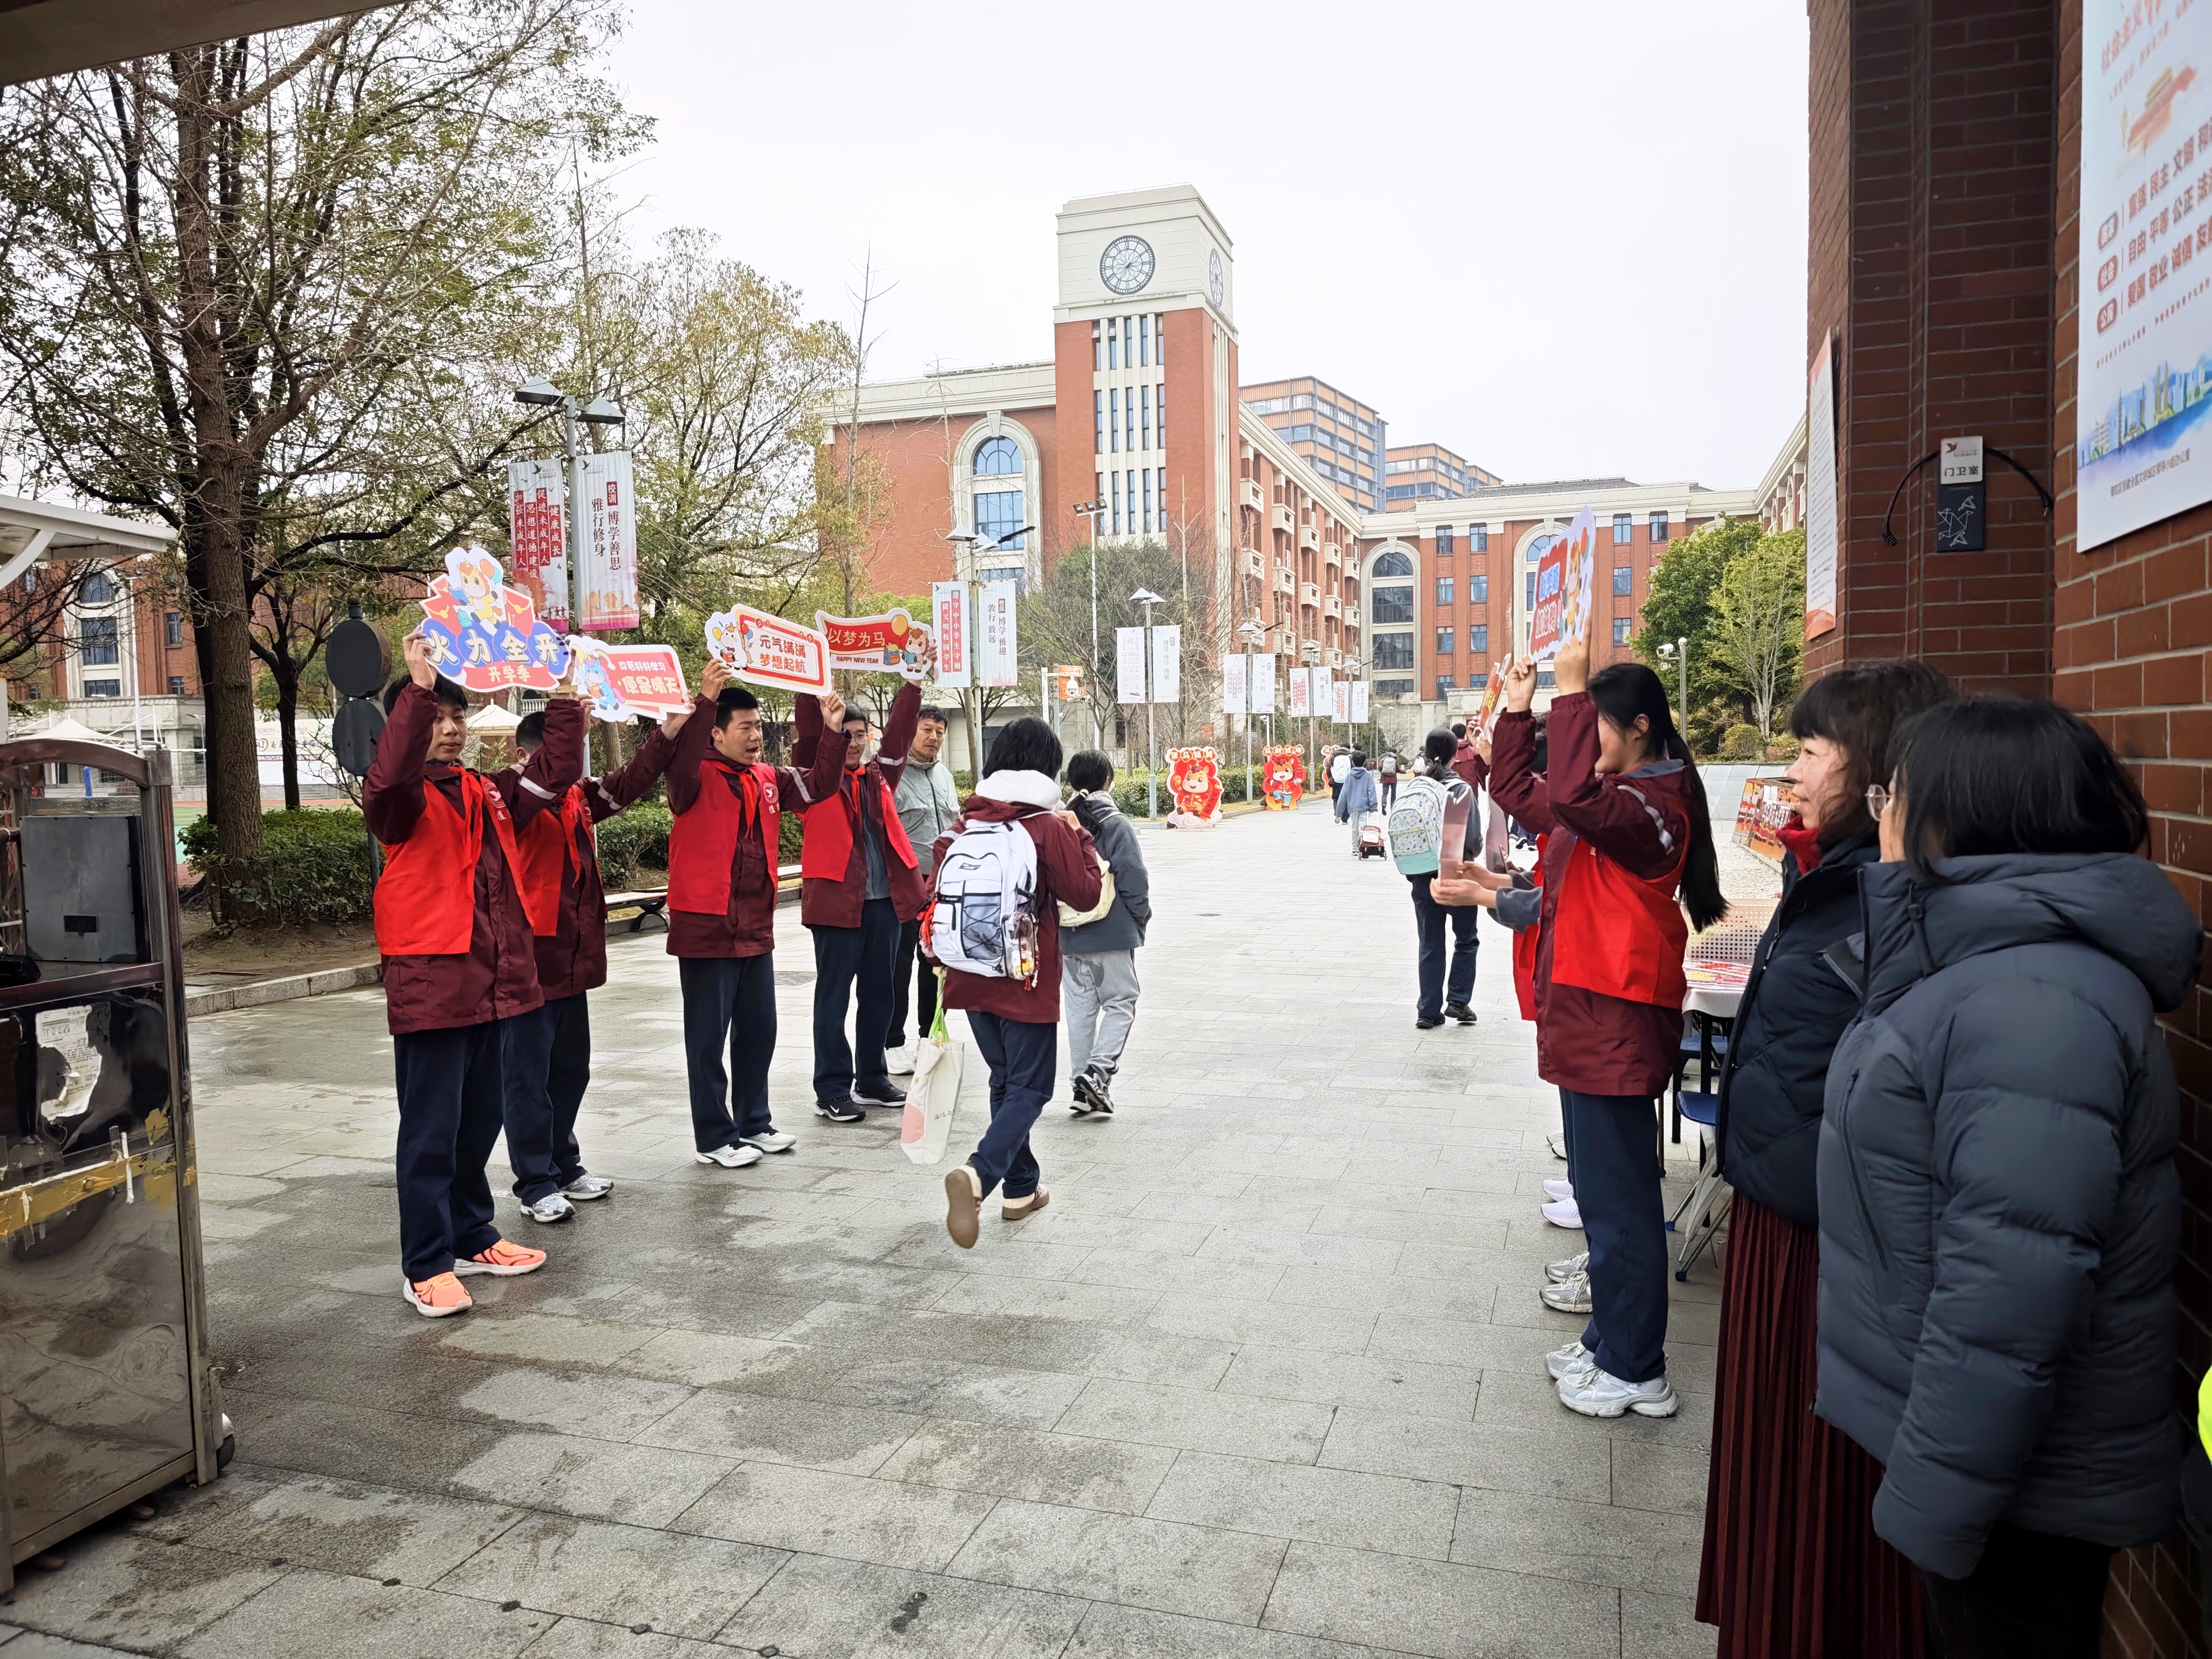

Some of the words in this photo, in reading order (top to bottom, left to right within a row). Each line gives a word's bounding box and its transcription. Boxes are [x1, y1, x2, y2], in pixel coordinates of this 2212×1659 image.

[2129, 230, 2146, 265] 自由
[2173, 185, 2193, 225] 公正
[1944, 466, 1979, 477] 门卫室
[608, 484, 617, 503] 校训
[515, 492, 527, 567] 加强未成年人
[527, 503, 538, 578] 思想道德建设
[537, 489, 550, 565] 促进未成年人
[550, 506, 562, 556] 健康成长
[591, 498, 606, 557] 雅行修身
[608, 511, 621, 570] 博学善思
[988, 604, 996, 643] 敦行致远
[999, 600, 1005, 612] 校风
[426, 629, 559, 665] 火力全开
[759, 635, 806, 658] 元气满满
[828, 628, 885, 647] 以梦为马
[942, 602, 950, 671] 做文明校园学生
[952, 591, 961, 670] 遵守中小学生守则
[999, 617, 1007, 655] 博学雅趣
[488, 664, 531, 683] 开学季
[618, 660, 666, 672] 你若好好学习
[759, 652, 806, 673] 梦想起航
[621, 676, 680, 694] 便是晴天
[1171, 750, 1213, 759] 策马扬鞭
